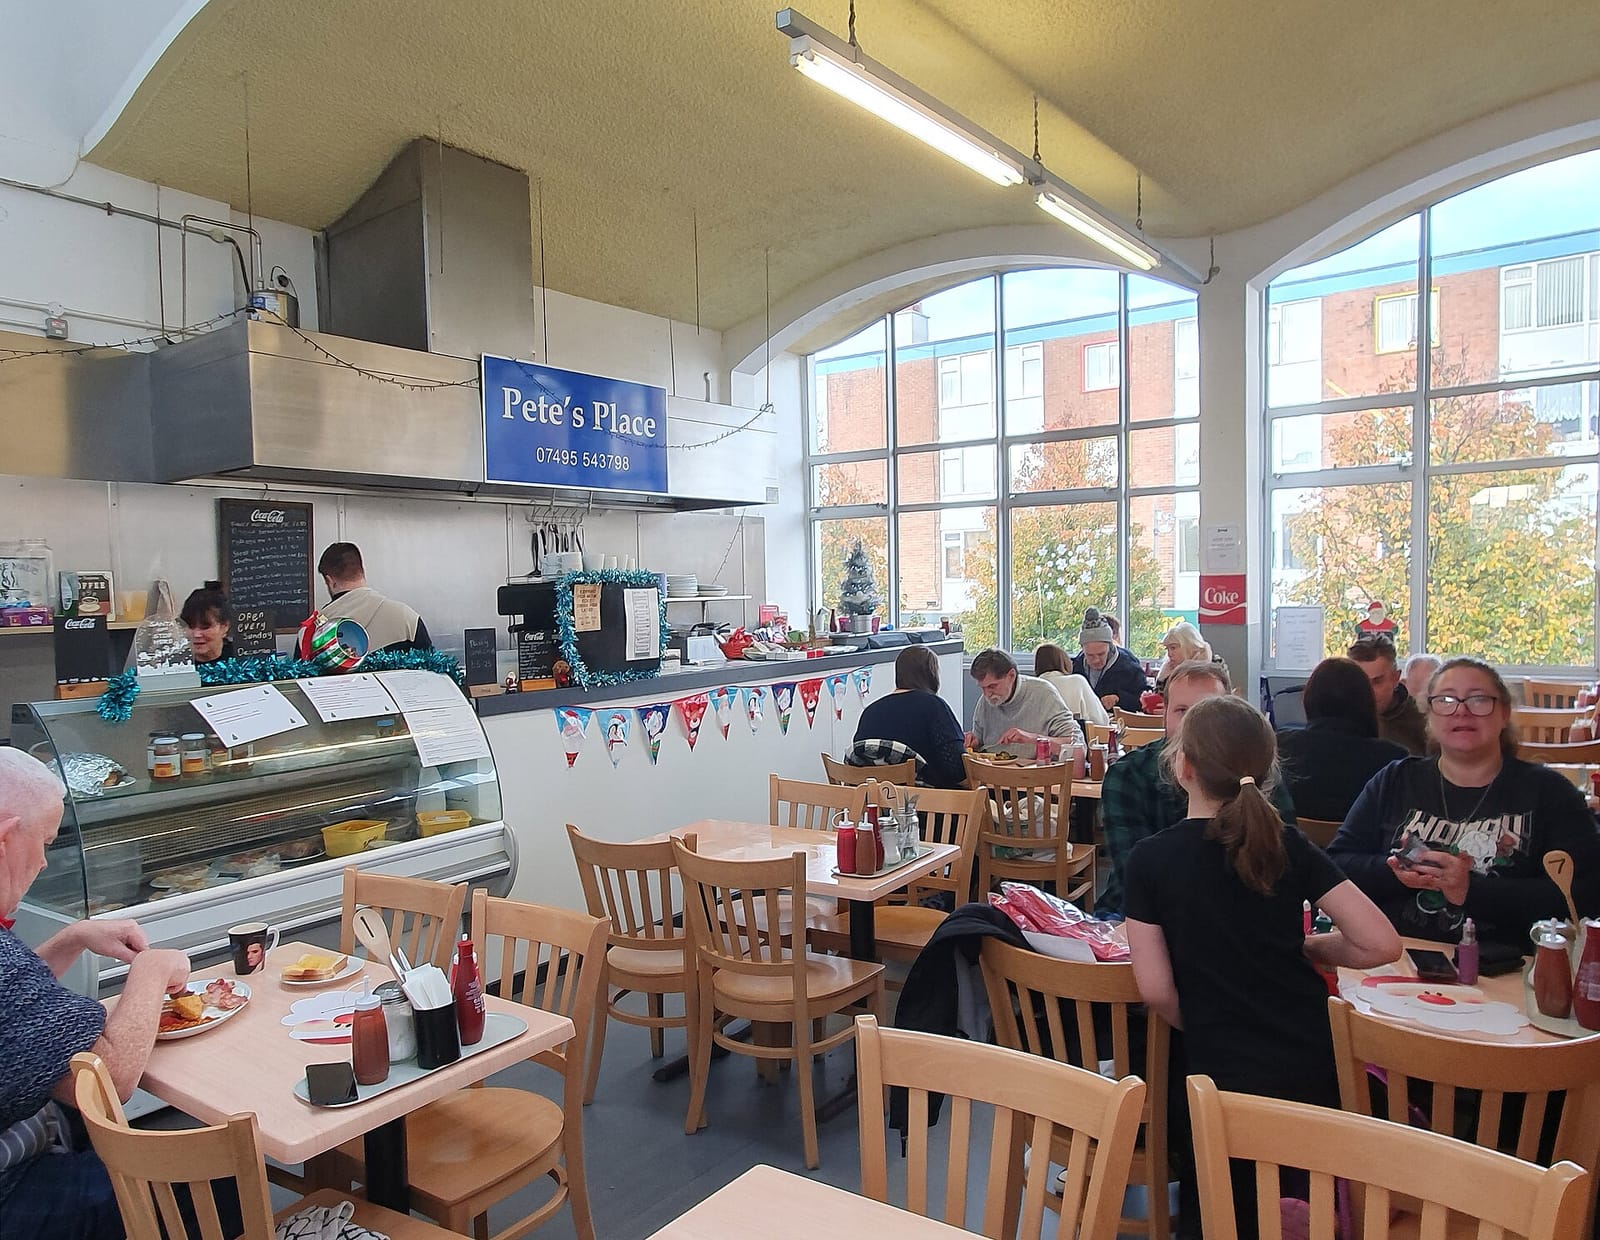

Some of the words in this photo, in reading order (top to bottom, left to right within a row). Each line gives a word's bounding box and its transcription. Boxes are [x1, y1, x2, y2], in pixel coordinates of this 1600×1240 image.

[501, 386, 585, 429] Pete's
[592, 401, 657, 438] Place
[535, 446, 578, 467] 07495
[583, 449, 631, 471] 543798
[77, 581, 106, 590] OFFEE
[1204, 587, 1240, 605] Coke
[881, 786, 897, 800] 2
[1547, 858, 1566, 874] 7
[360, 915, 375, 938] 1
